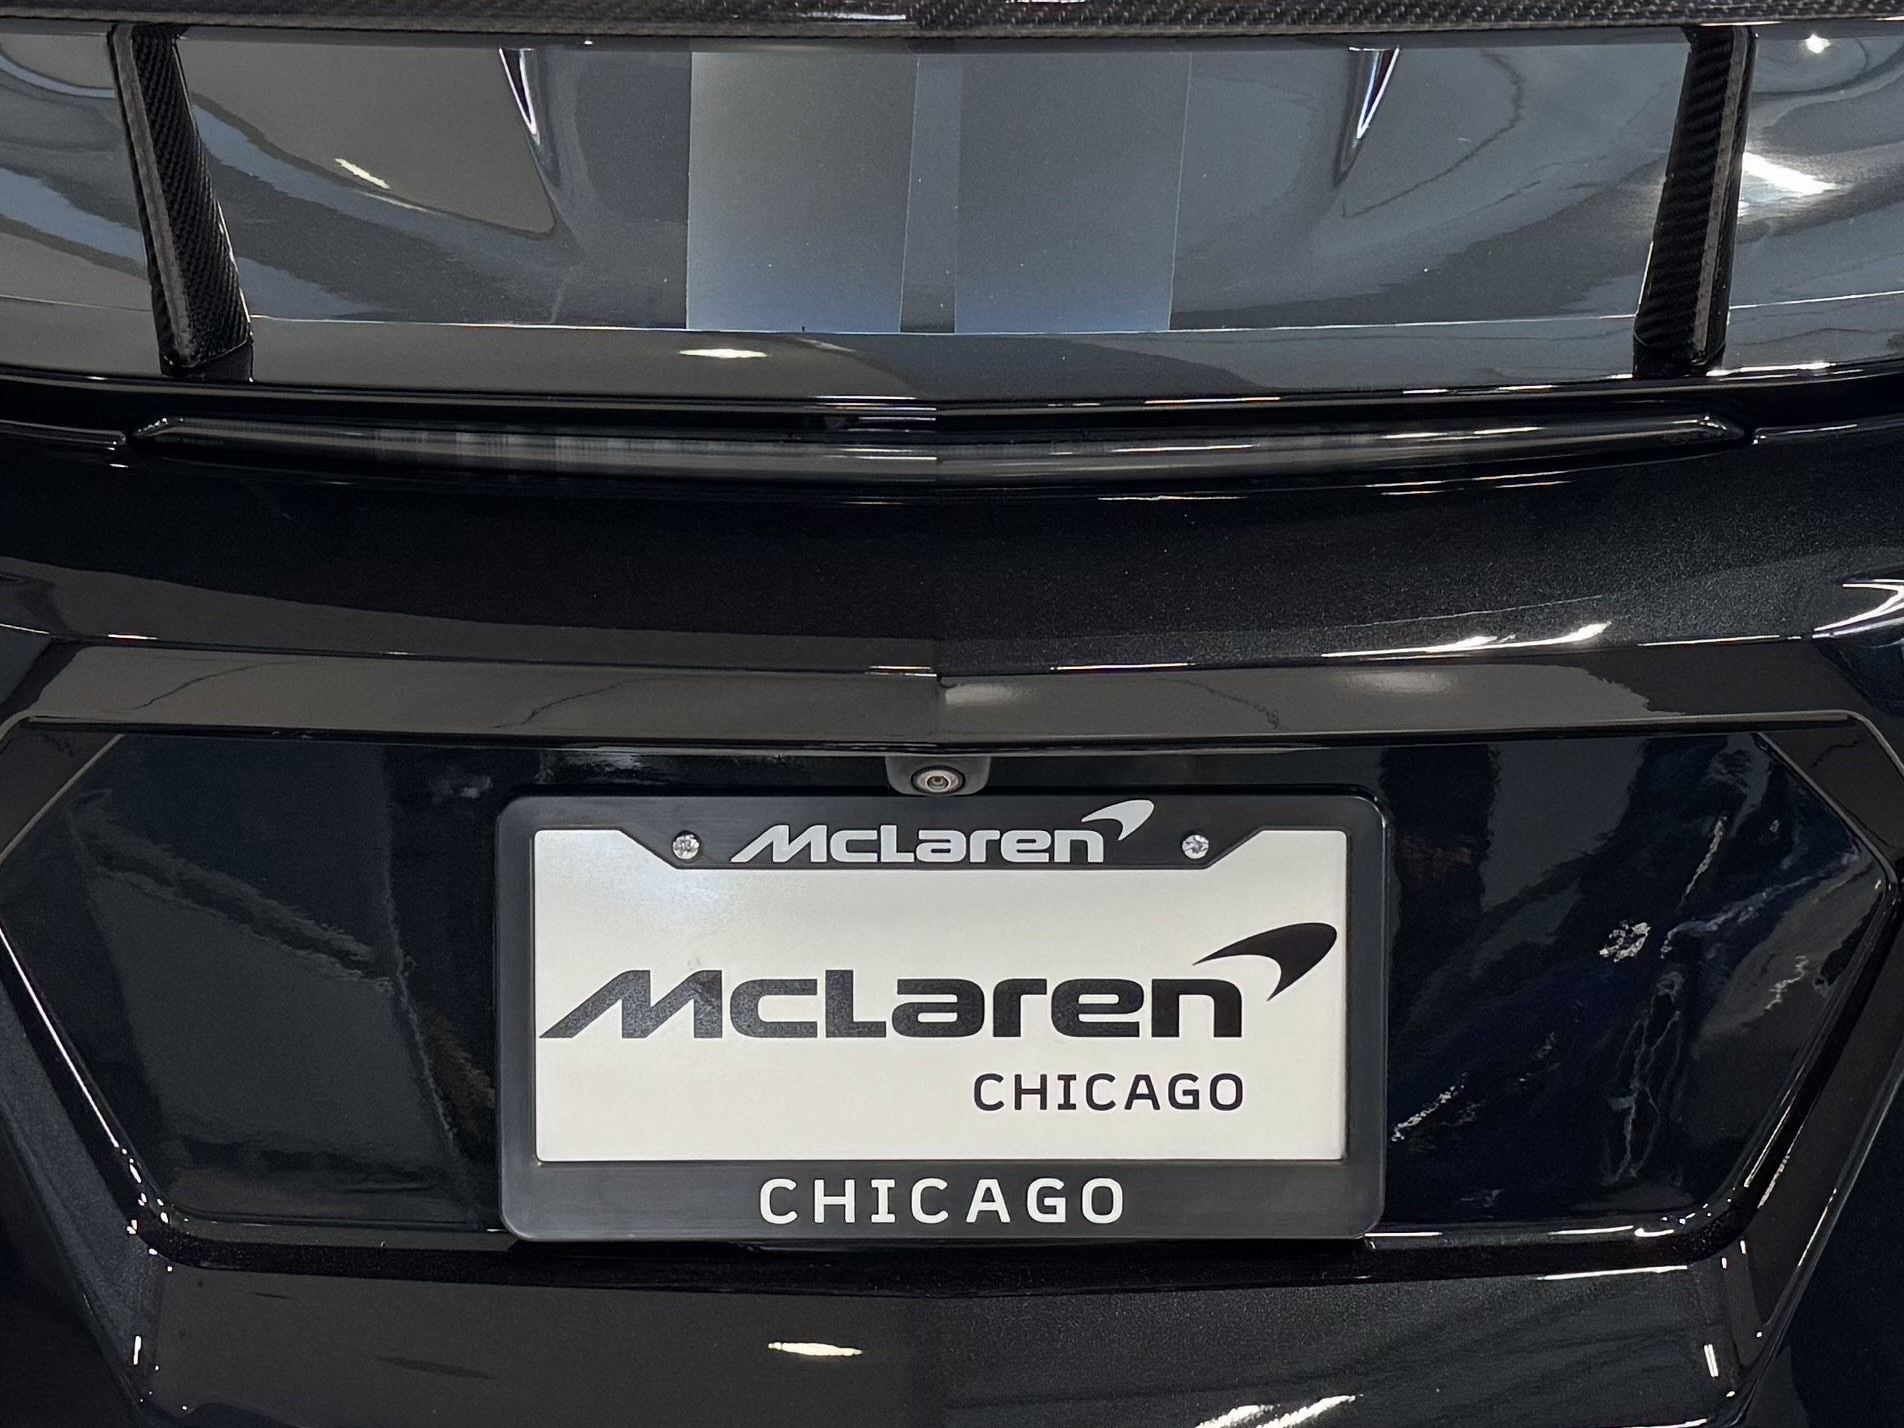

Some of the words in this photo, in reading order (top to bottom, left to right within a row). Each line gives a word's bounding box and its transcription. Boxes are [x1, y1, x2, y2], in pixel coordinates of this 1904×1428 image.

[731, 823, 1105, 864] McLaren
[539, 969, 1243, 1039] McLaren
[973, 1073, 1245, 1112] CHICAGO
[760, 1178, 1125, 1224] CHICAGO
